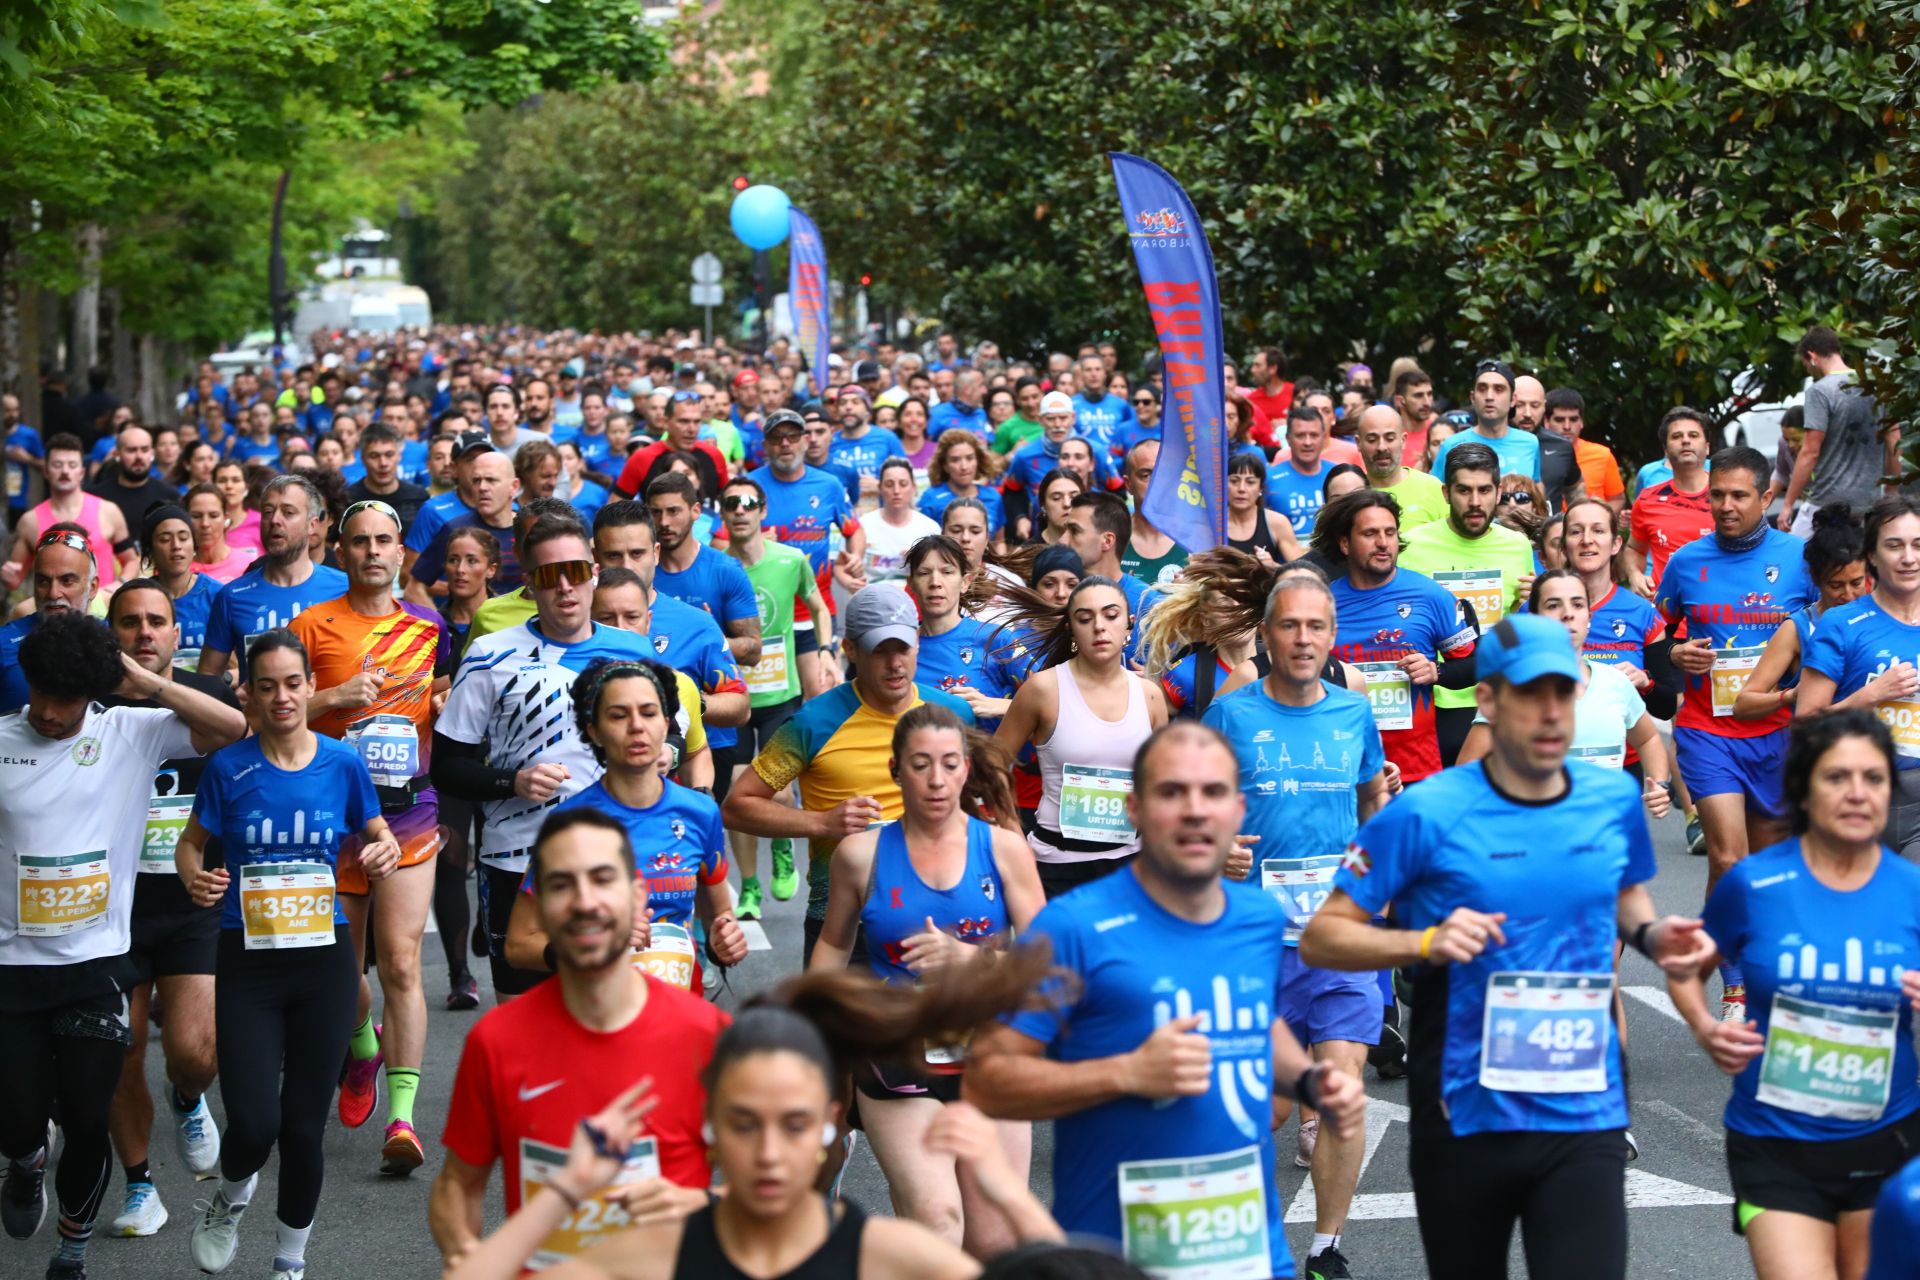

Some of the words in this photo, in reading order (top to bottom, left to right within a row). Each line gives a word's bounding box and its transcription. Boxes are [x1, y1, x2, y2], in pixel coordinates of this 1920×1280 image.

[1728, 674, 1752, 693] 3
[0, 757, 37, 766] ELME
[366, 742, 410, 762] 505
[368, 762, 407, 771] ALFREDO
[1079, 794, 1125, 817] 189
[1087, 816, 1125, 826] URTUBIA
[146, 826, 186, 846] 23
[40, 881, 107, 908] 3223
[891, 887, 904, 909] K
[51, 909, 64, 917] LA
[67, 904, 96, 916] PERLA
[262, 895, 331, 919] 3526
[287, 919, 309, 928] ANE
[1527, 1018, 1595, 1050] 482
[1794, 1043, 1886, 1085] 1484
[560, 1199, 630, 1232] 24
[1160, 1199, 1260, 1245] 1290
[1177, 1237, 1248, 1261] ALBERTO
